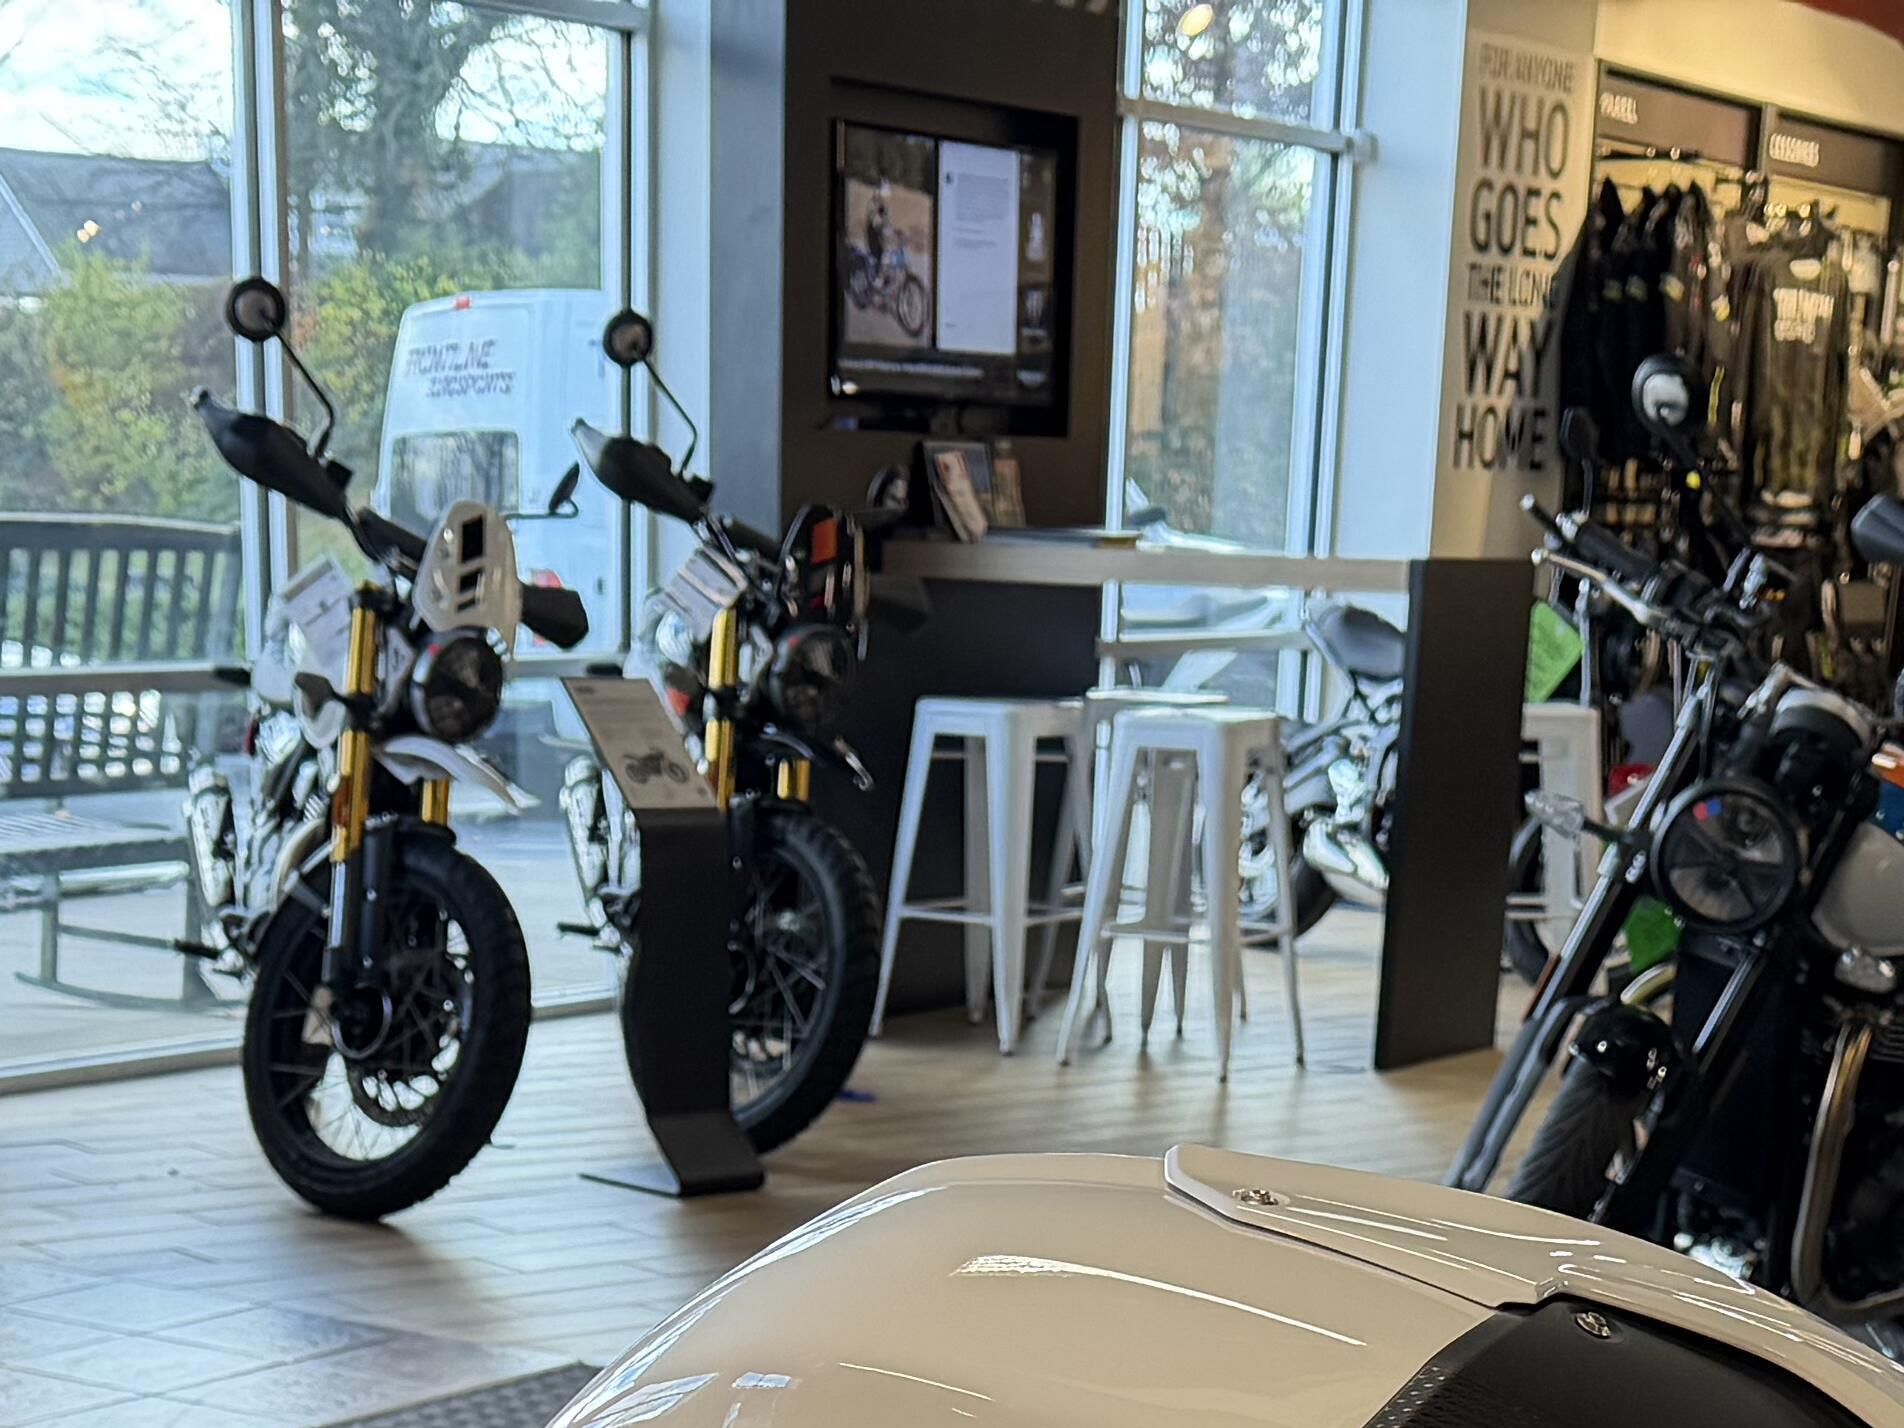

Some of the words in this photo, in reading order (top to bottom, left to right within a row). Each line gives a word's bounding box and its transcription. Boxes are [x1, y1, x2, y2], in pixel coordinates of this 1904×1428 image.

[1477, 86, 1570, 180] WHO
[1470, 177, 1563, 261] GOES
[1467, 262, 1502, 306] THE
[1463, 312, 1556, 399] WAY
[1453, 404, 1546, 471] HOME
